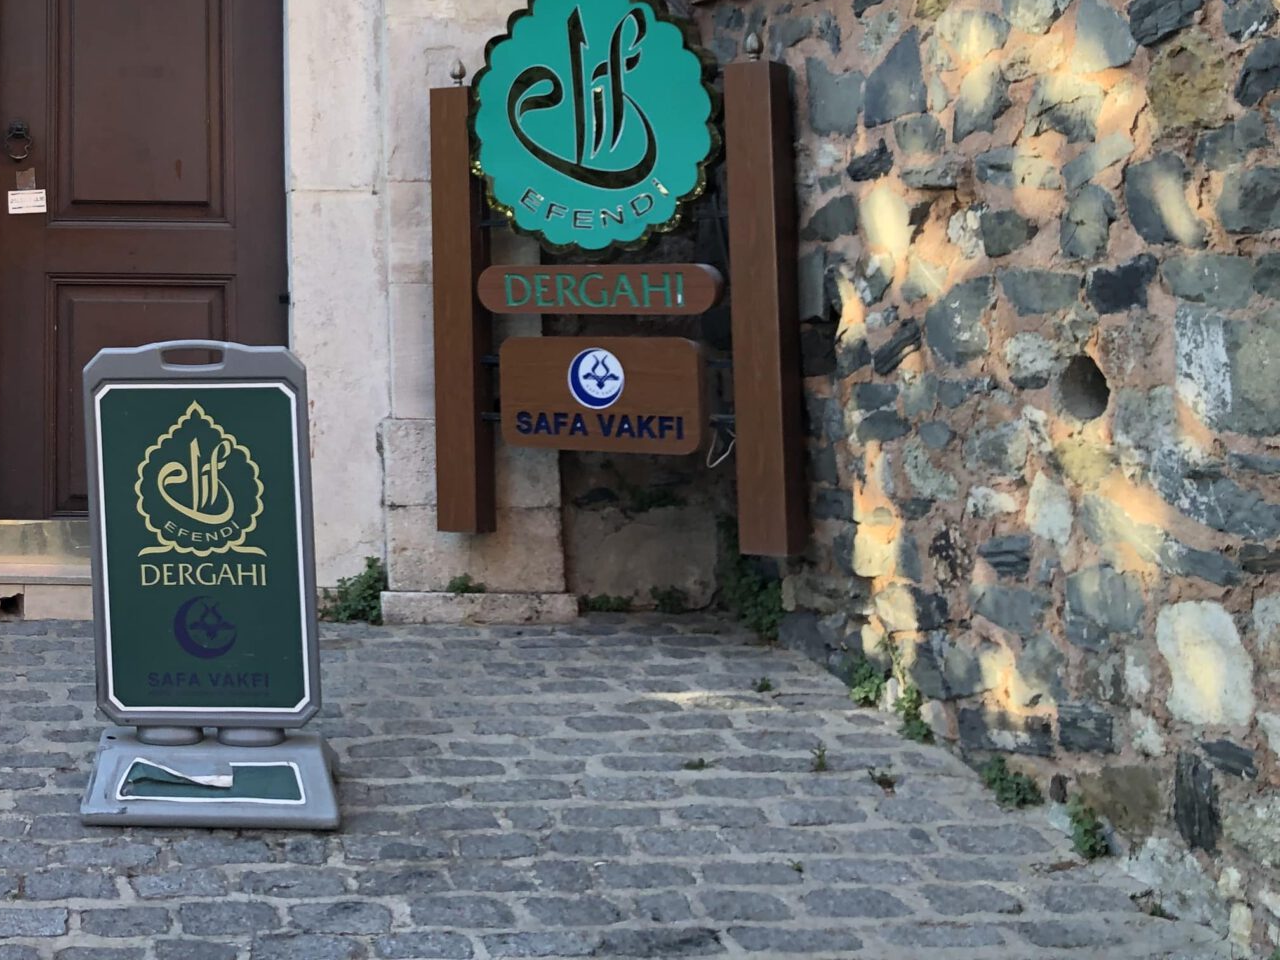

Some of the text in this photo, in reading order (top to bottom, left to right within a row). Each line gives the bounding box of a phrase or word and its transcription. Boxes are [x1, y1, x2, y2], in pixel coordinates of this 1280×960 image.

[507, 5, 657, 189] elif
[504, 272, 685, 308] DERGAHI
[516, 411, 685, 440] SAFA VAKFI
[157, 437, 235, 525] elif
[140, 563, 267, 586] DERGAHI
[147, 672, 270, 688] SAFA VAKFI
